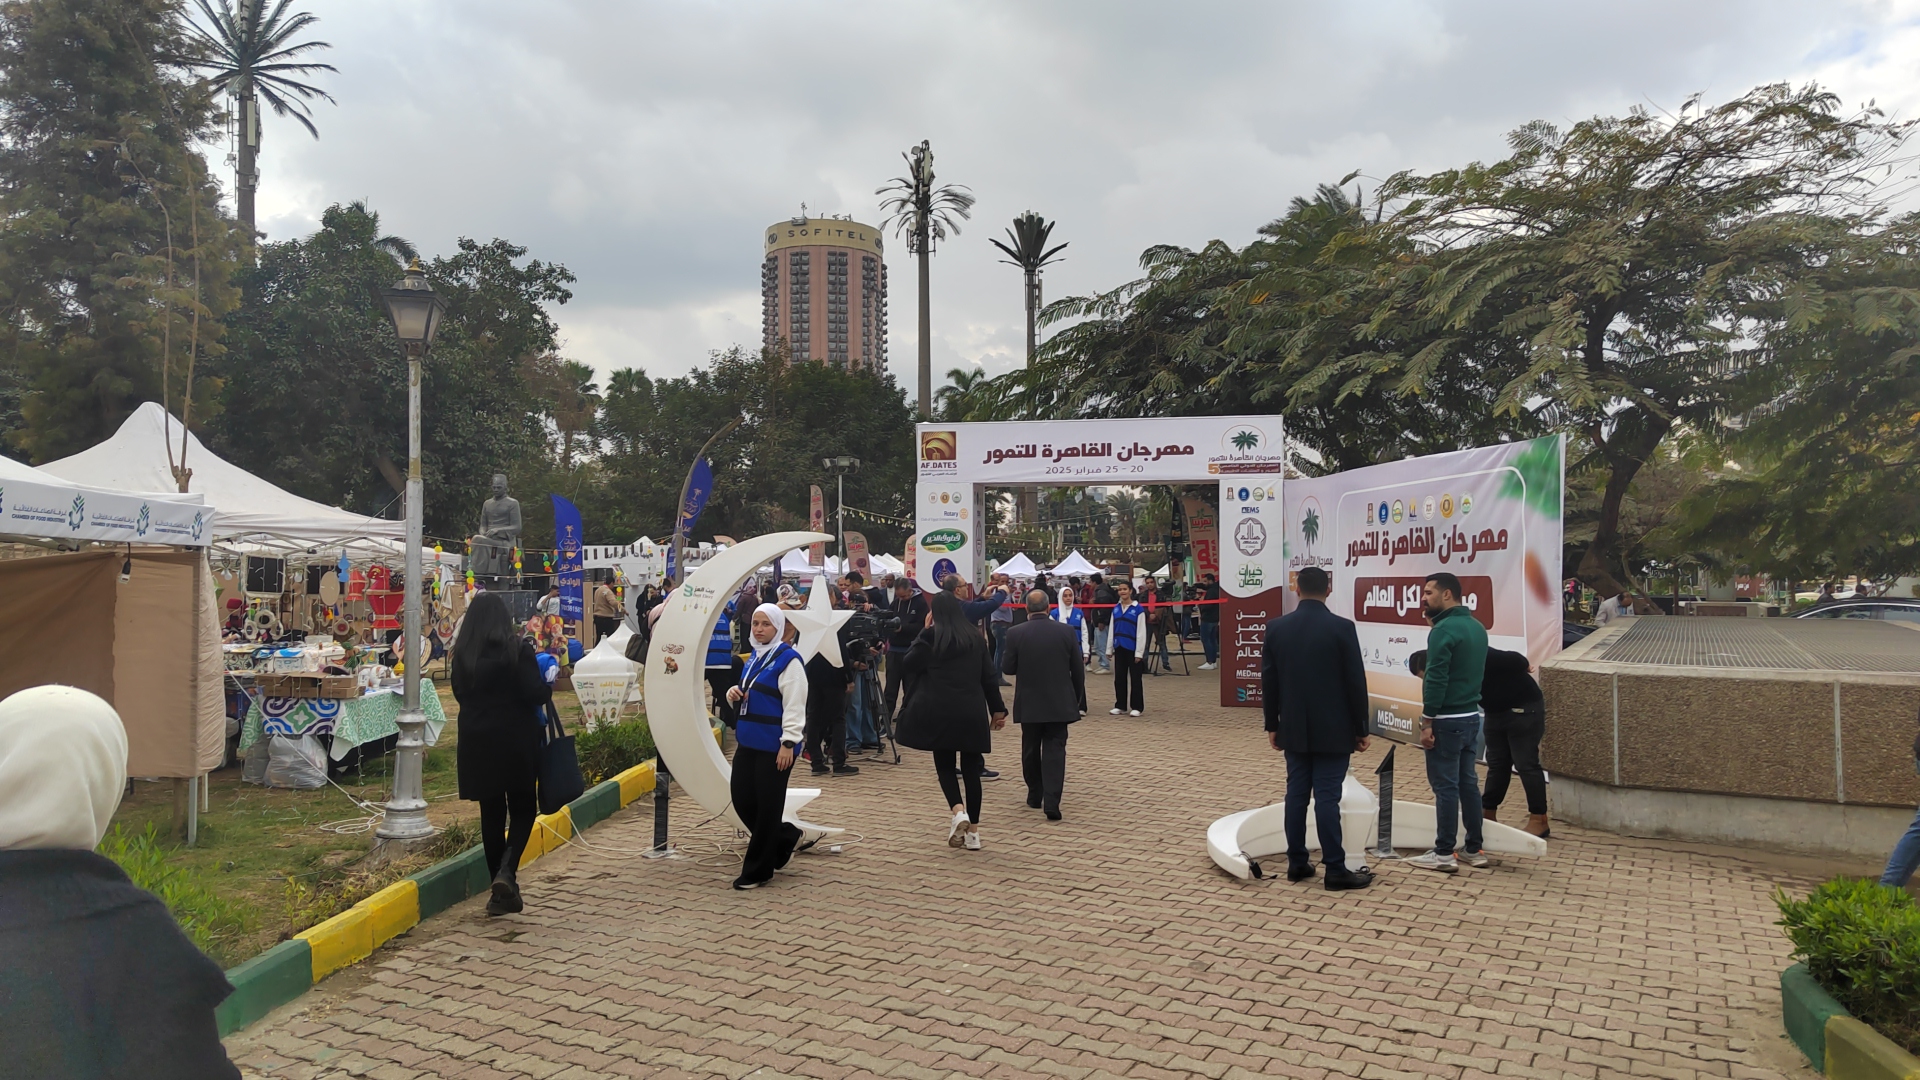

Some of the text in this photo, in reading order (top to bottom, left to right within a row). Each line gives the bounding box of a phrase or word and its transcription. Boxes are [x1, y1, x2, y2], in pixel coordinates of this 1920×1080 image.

[788, 228, 866, 241] SOFITEL
[982, 442, 1195, 465] مهرجان القاهرة للتمور
[1076, 466, 1102, 476] فبراير
[1105, 466, 1118, 474] 25
[1130, 465, 1144, 473] 20
[1345, 524, 1509, 567] مهرجان القاهرة للتمور
[1239, 576, 1263, 588] رمضان
[1363, 585, 1395, 615] العالم
[1396, 583, 1421, 617] لكل
[1236, 609, 1267, 621] من
[1235, 622, 1267, 634] مصر
[1236, 669, 1262, 678] MEDma
[1377, 709, 1413, 731] MEDmart
